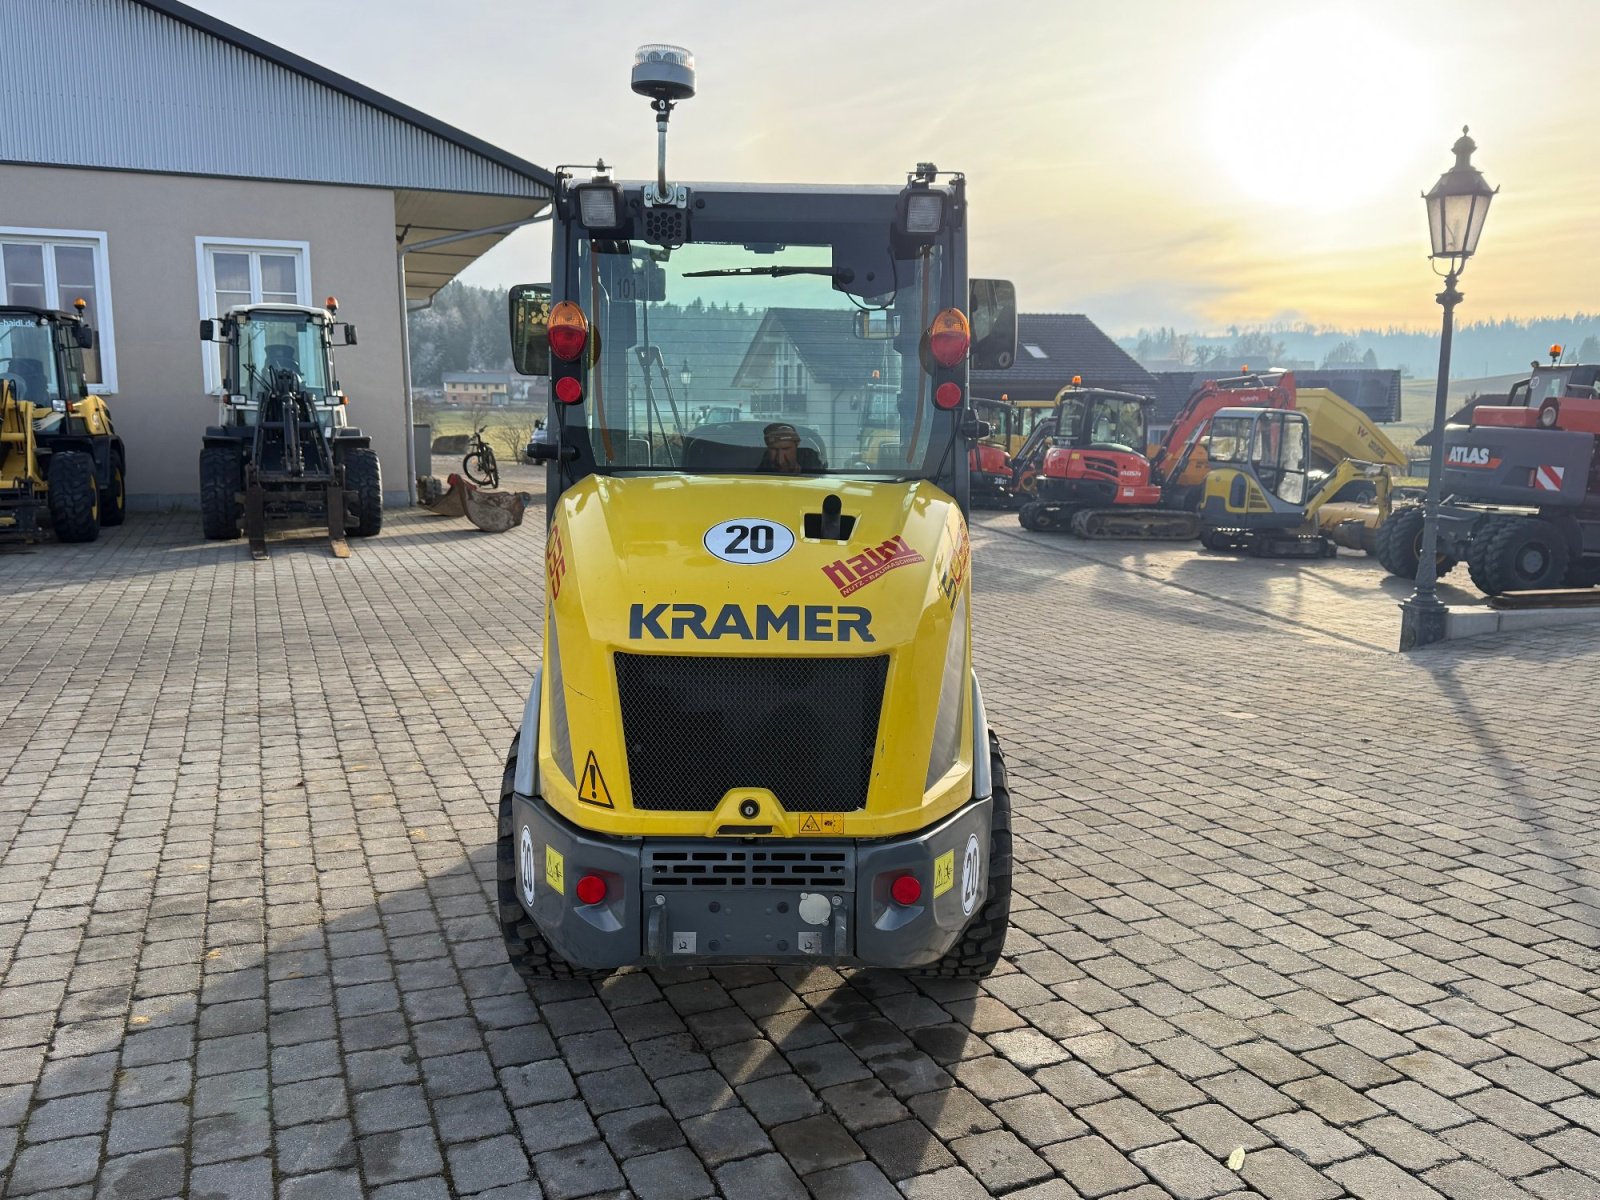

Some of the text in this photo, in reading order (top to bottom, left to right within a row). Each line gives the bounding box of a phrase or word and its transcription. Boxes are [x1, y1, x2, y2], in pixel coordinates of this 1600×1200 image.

[617, 278, 636, 299] 101
[1448, 446, 1490, 465] ATLAS
[724, 525, 774, 554] 20
[843, 580, 865, 596] NUTZ
[628, 603, 877, 643] KRAMER
[522, 839, 533, 893] 20
[964, 847, 977, 904] 20
